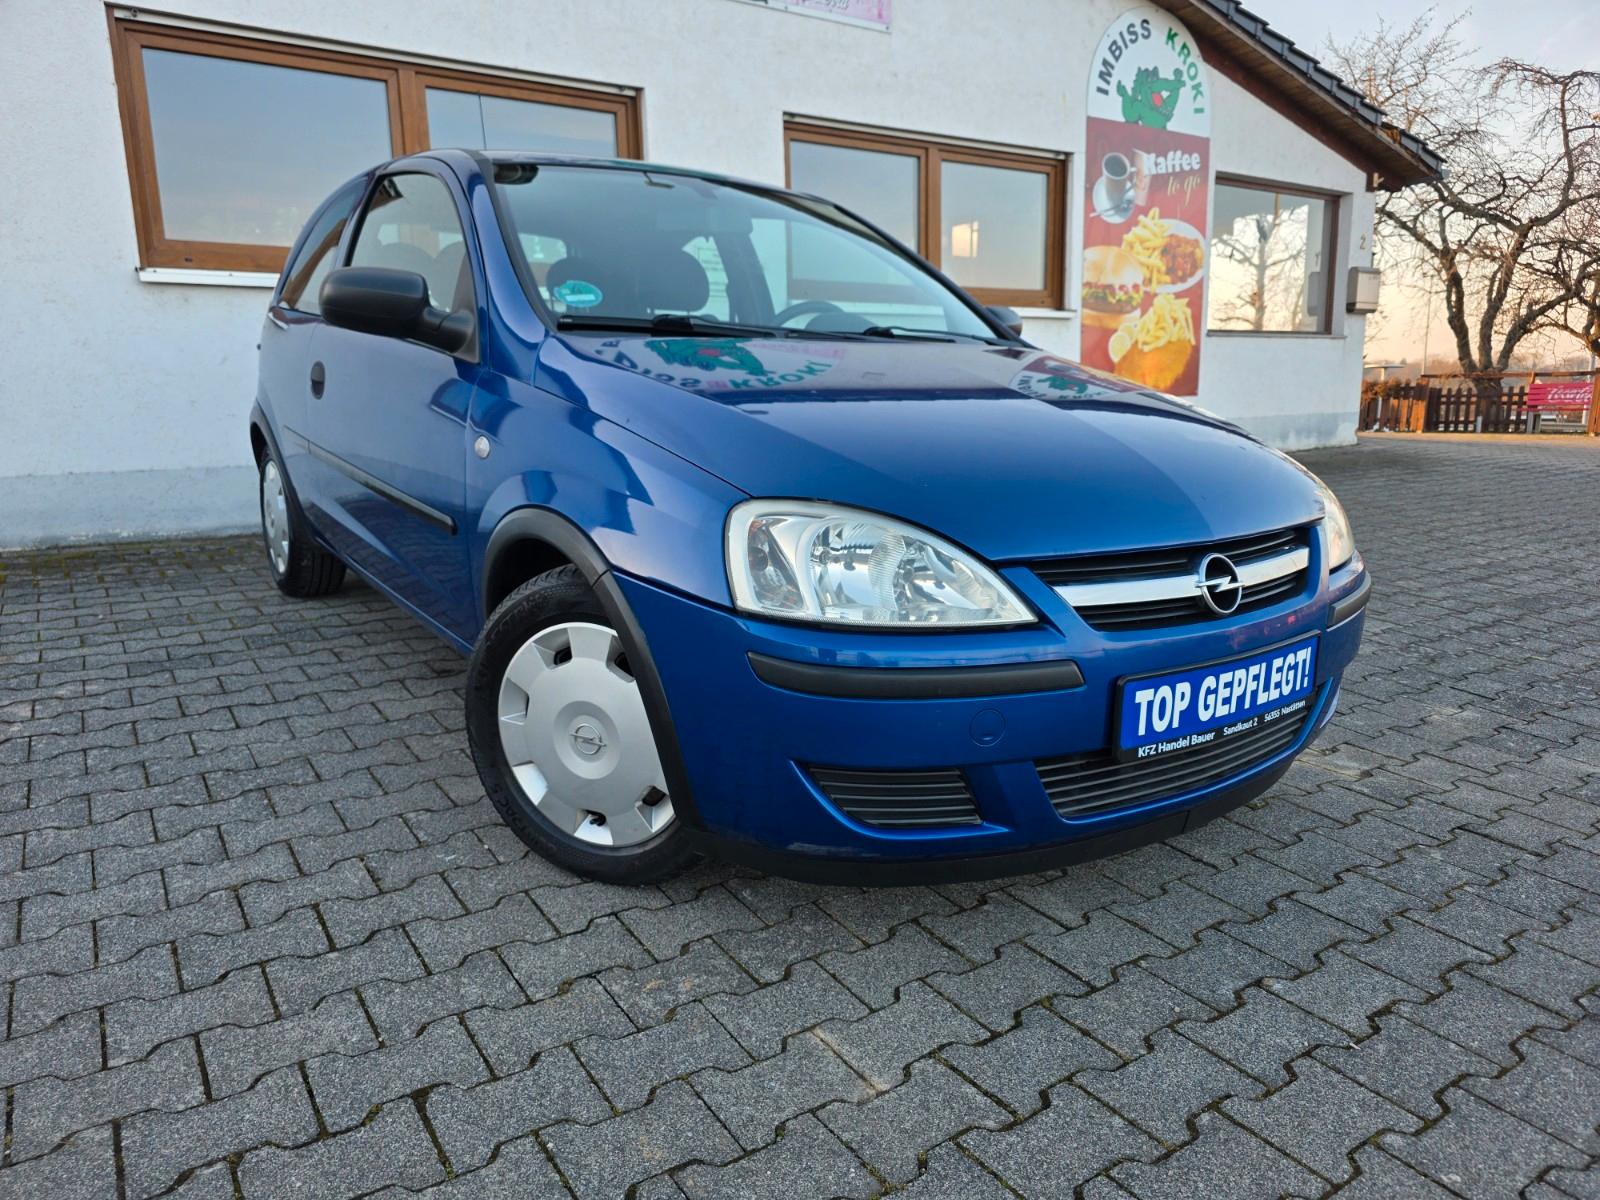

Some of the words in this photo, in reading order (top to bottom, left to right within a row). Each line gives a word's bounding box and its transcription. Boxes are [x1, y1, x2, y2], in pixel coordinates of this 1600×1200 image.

[1096, 19, 1151, 96] IMBISS
[1165, 27, 1205, 114] KROKI
[1142, 150, 1201, 176] Kaffee
[1135, 682, 1192, 736] TOP
[1197, 646, 1312, 722] GEPFLEGT!
[1138, 744, 1157, 758] KFZ
[1158, 735, 1190, 753] Handel
[1191, 732, 1215, 745] Bauer
[1223, 720, 1253, 736] Sandkaut
[1253, 717, 1258, 727] 2
